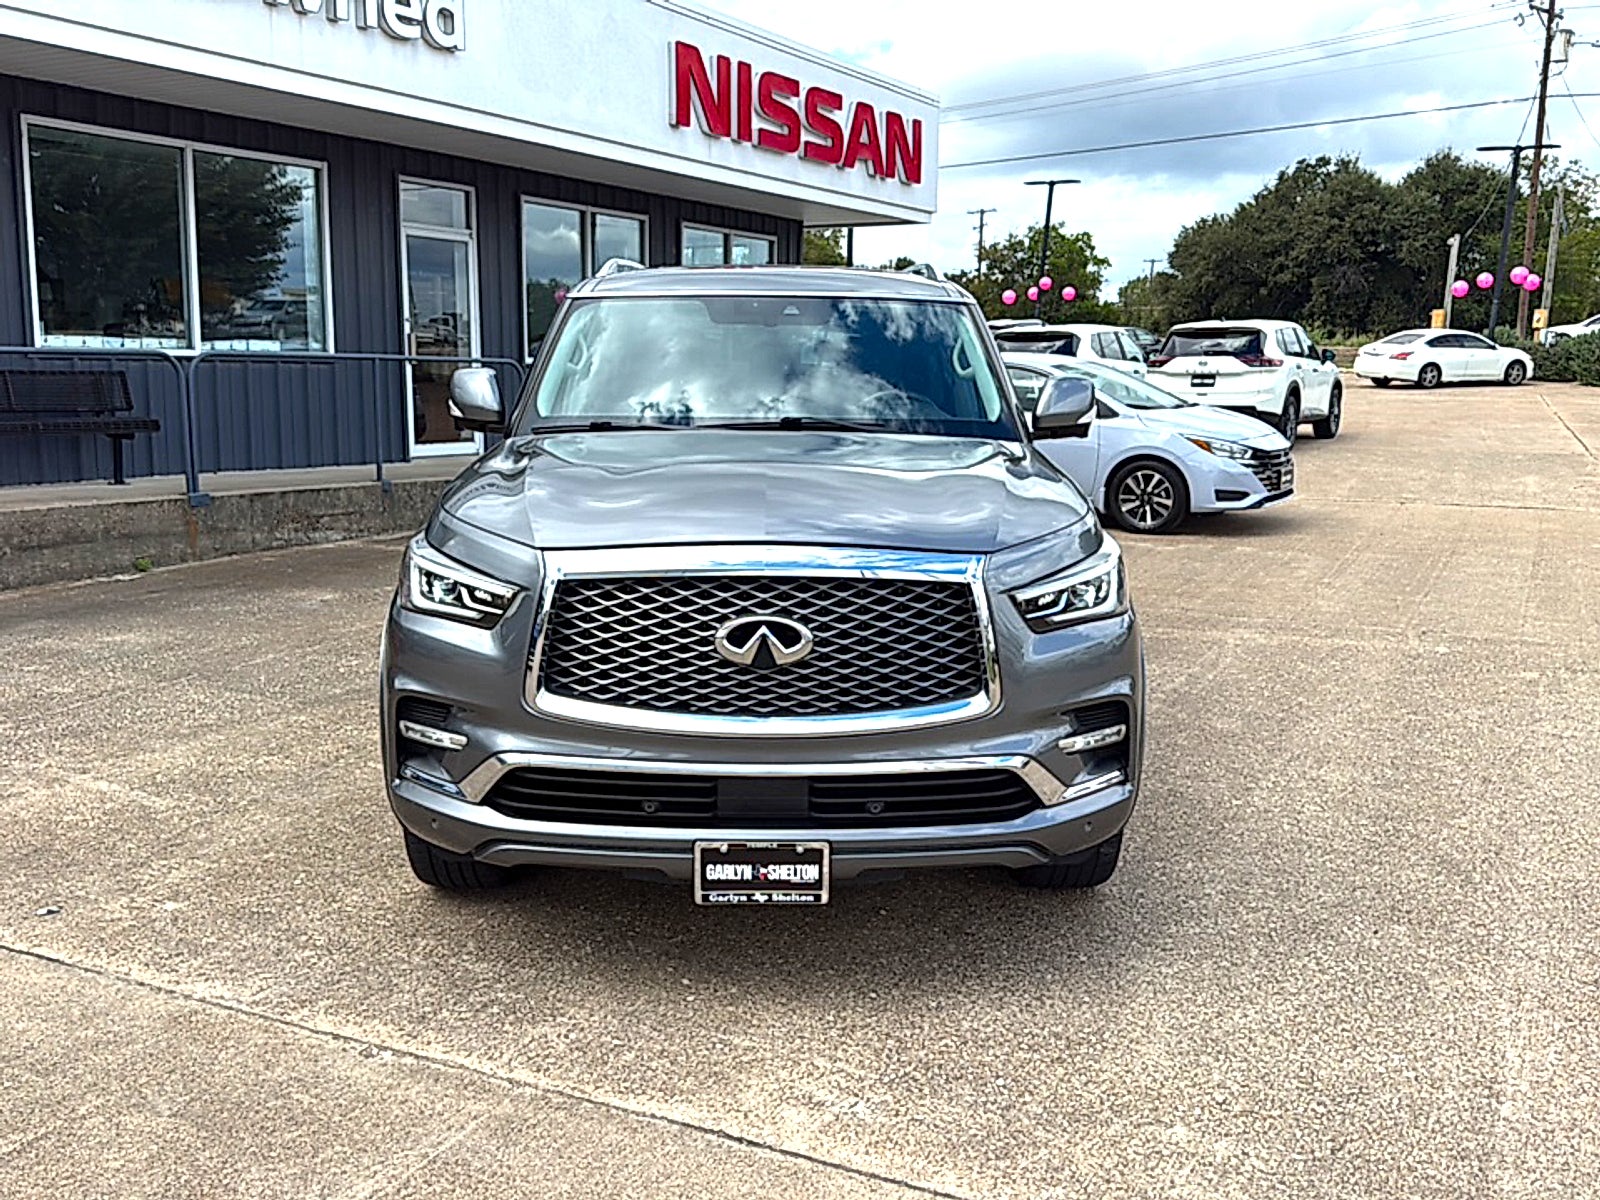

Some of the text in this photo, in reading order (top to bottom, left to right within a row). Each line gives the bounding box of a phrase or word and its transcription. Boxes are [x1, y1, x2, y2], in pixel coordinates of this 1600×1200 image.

[670, 41, 922, 184] NISSAN
[706, 864, 819, 880] GARLYN SHELTON
[771, 893, 814, 902] Shelton
